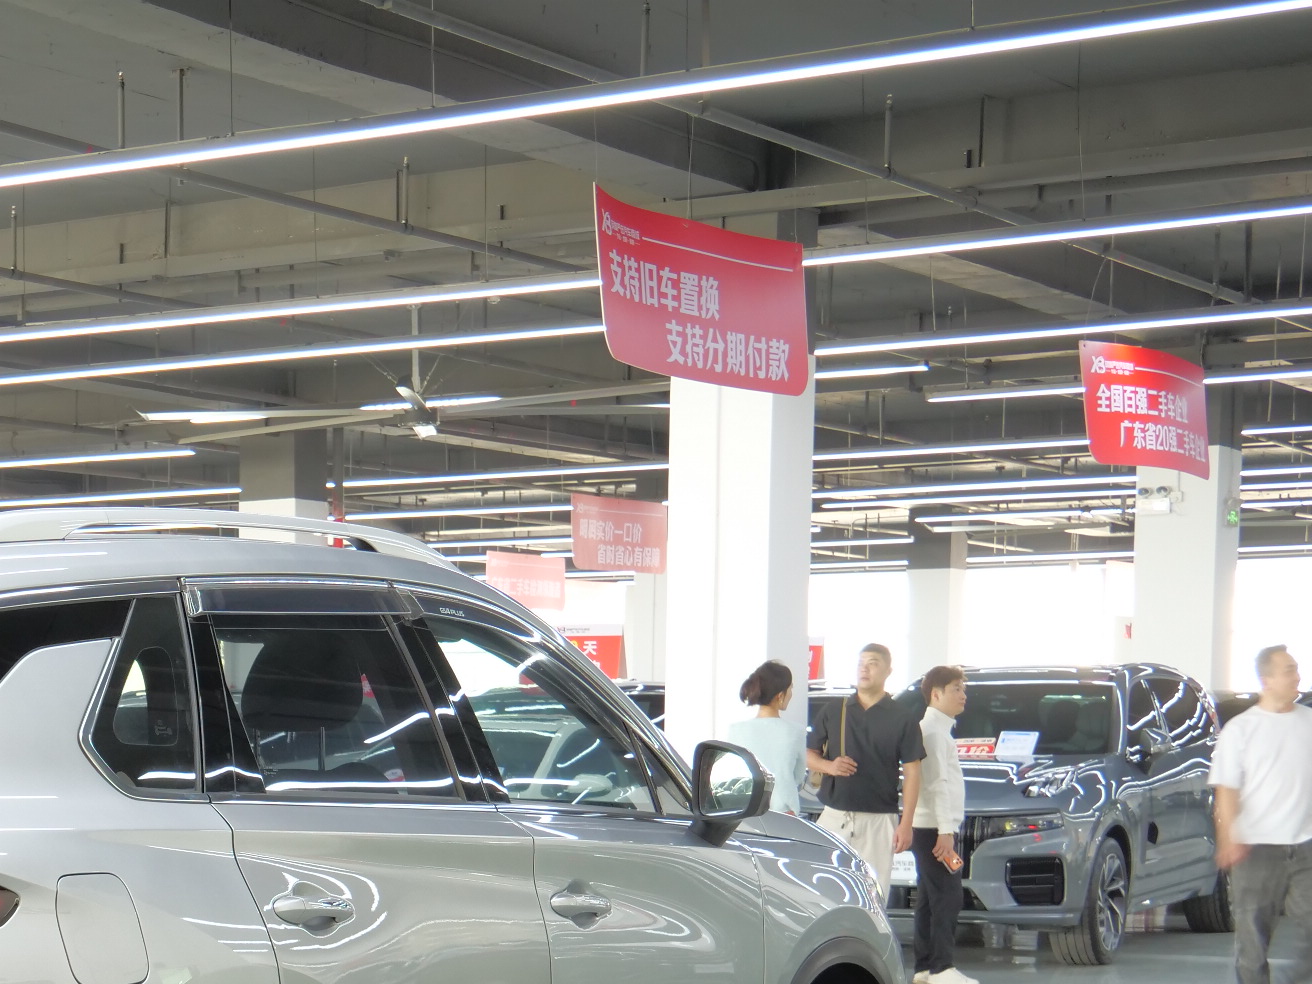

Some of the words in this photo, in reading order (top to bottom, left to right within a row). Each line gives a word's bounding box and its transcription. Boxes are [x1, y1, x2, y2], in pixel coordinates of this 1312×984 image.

[609, 249, 720, 321] 支持旧车置换
[665, 320, 790, 382] 支持分期付款
[1096, 384, 1189, 424] 全国百强二手车企业
[1120, 420, 1206, 463] 广东省20强二手车企业
